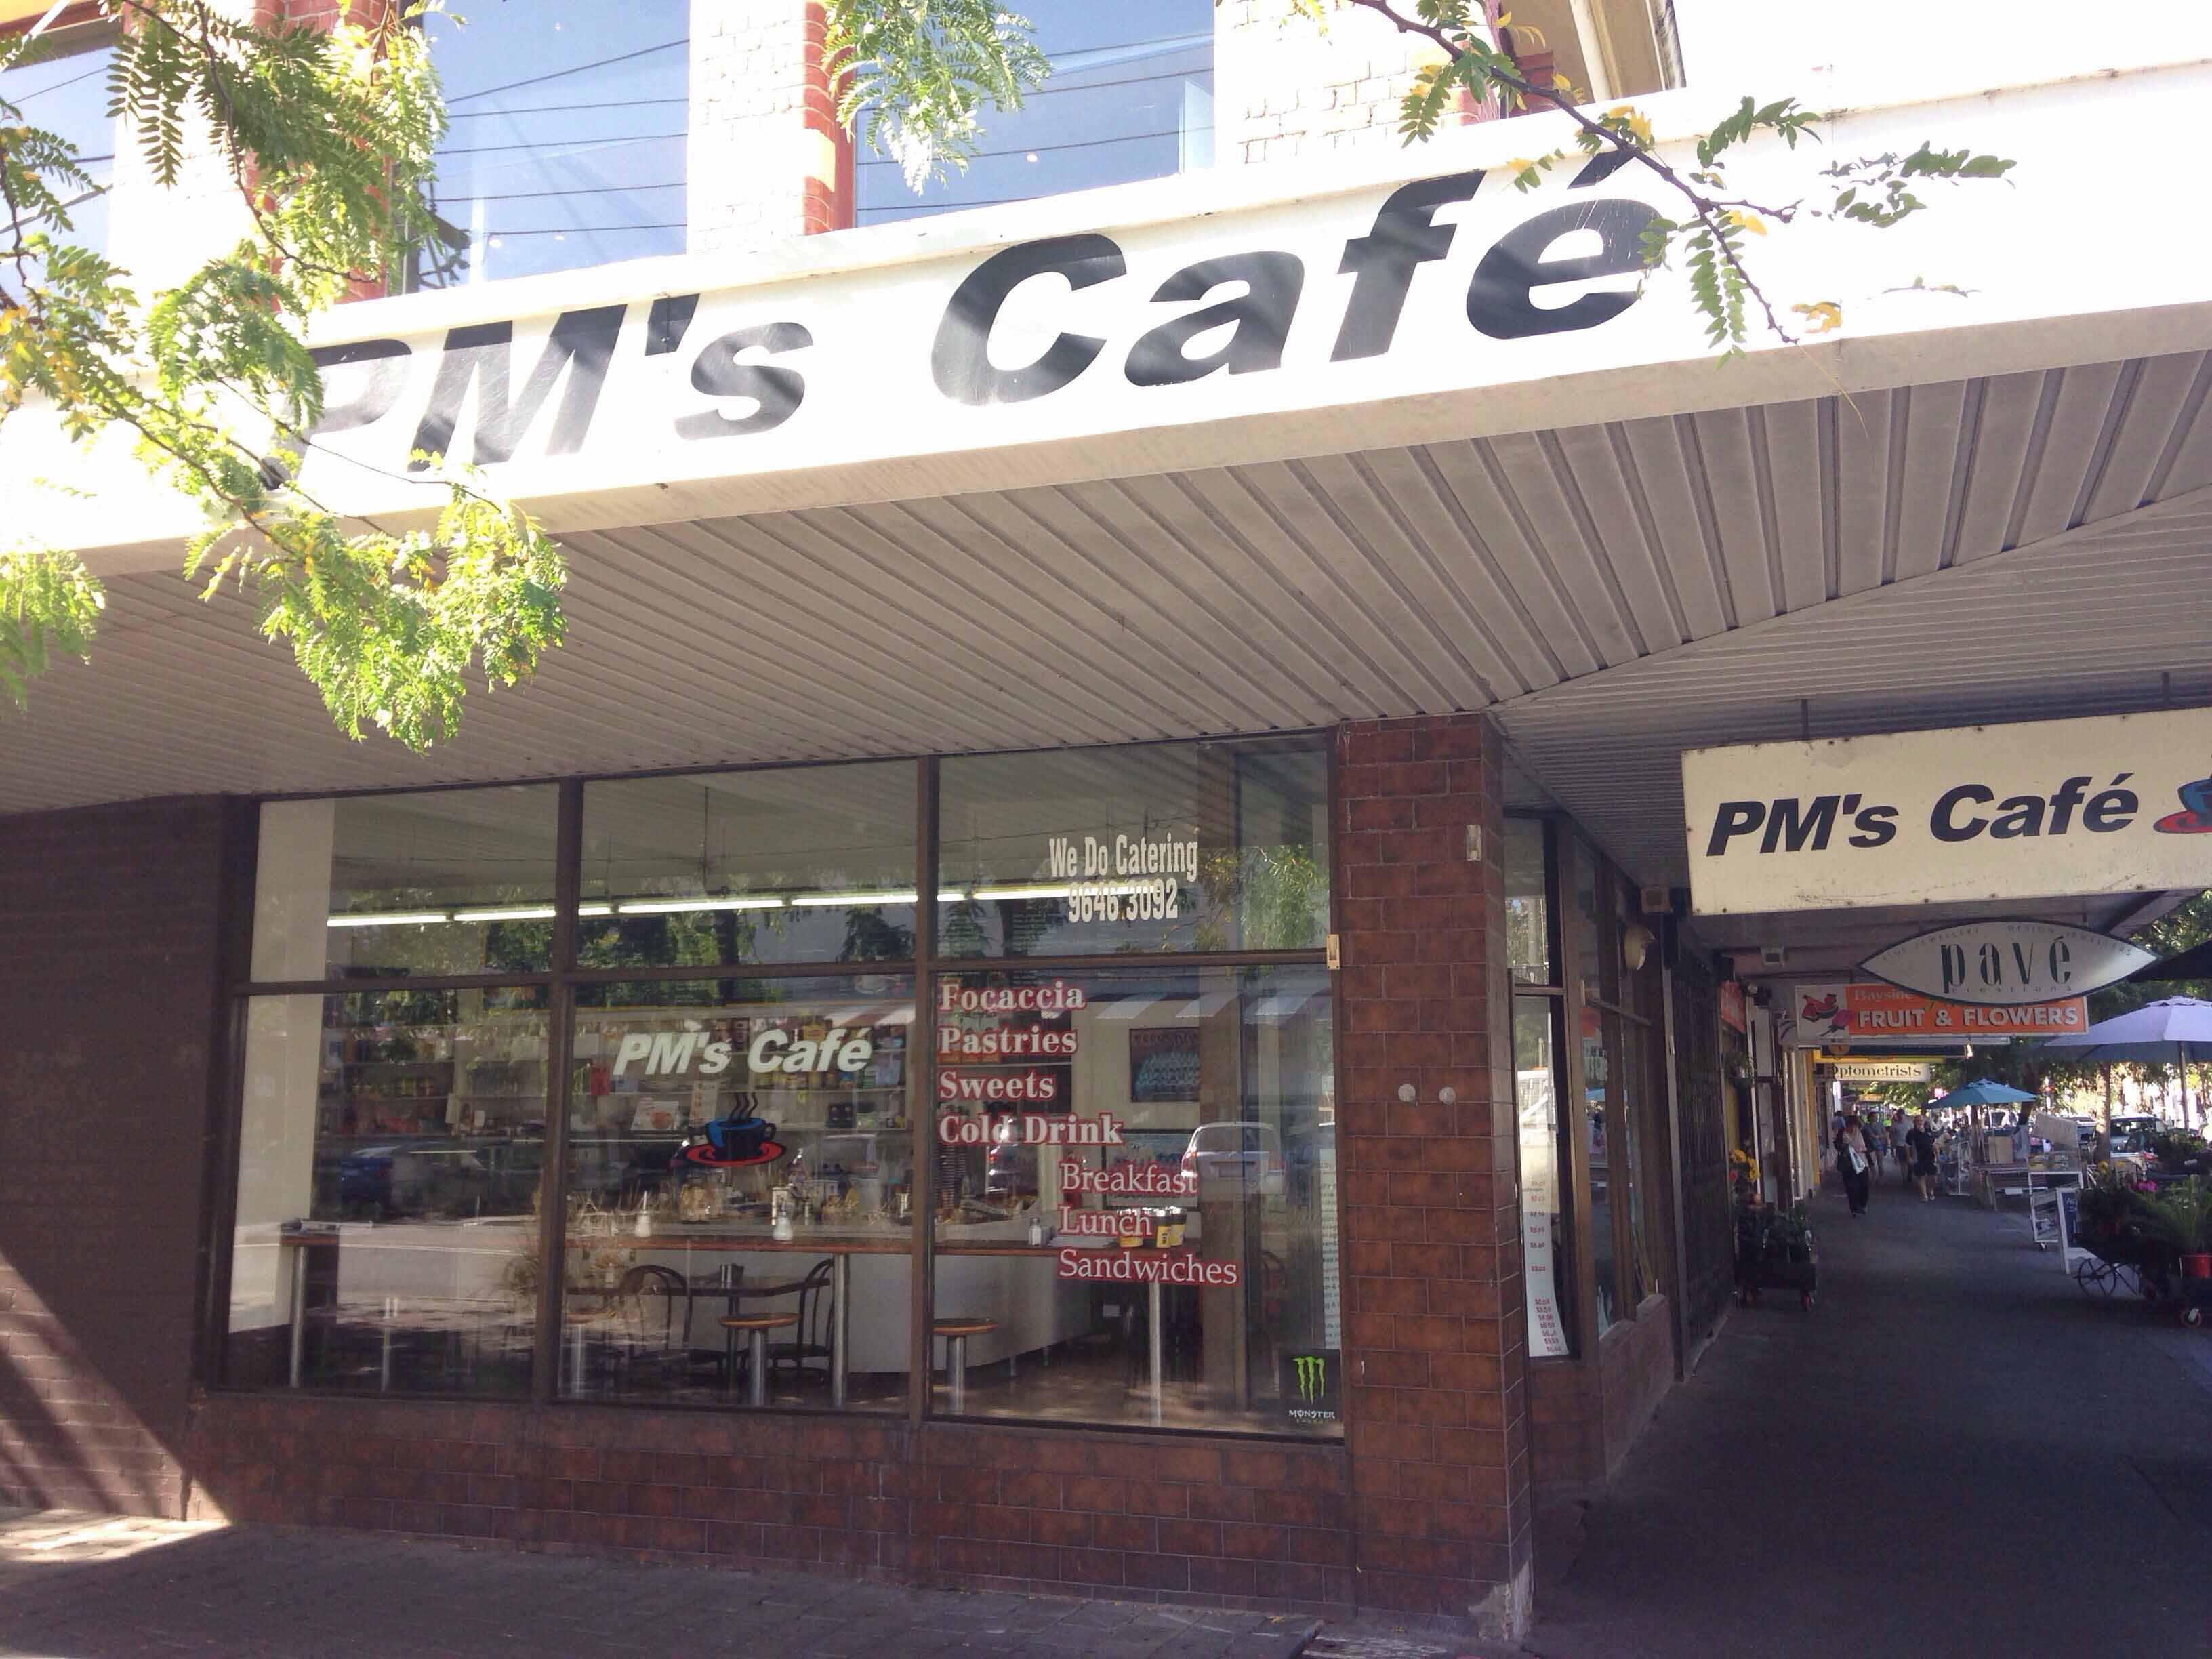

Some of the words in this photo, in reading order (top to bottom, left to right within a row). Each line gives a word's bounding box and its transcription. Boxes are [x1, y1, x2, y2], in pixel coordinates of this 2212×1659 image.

[259, 293, 815, 489] PM's
[930, 150, 1663, 407] Café
[1706, 794, 1899, 857] PM's
[1930, 773, 2139, 843] Café
[1048, 838, 1077, 878] We
[1084, 836, 1107, 875] Do
[1115, 832, 1198, 882] Catering
[1068, 882, 1118, 923] 9646
[1126, 878, 1178, 920] 3092
[1941, 935, 2072, 994] pavé
[938, 979, 1086, 1012] Focaccia
[1858, 1009, 1925, 1029] FRUIT
[1935, 1009, 1952, 1027] &
[1963, 1007, 2078, 1026] FLOWERS
[613, 1032, 733, 1076] PM's
[747, 1027, 874, 1073] Café
[938, 1025, 1078, 1054] Pastries
[938, 1067, 1055, 1099] Sweets
[938, 1112, 1014, 1144] Cold
[1024, 1113, 1124, 1145] Drink
[1060, 1162, 1198, 1194] Breakfast
[1059, 1205, 1153, 1236] Lunch
[1059, 1249, 1238, 1284] Sandwiches
[1288, 1409, 1336, 1420] MONSTER
